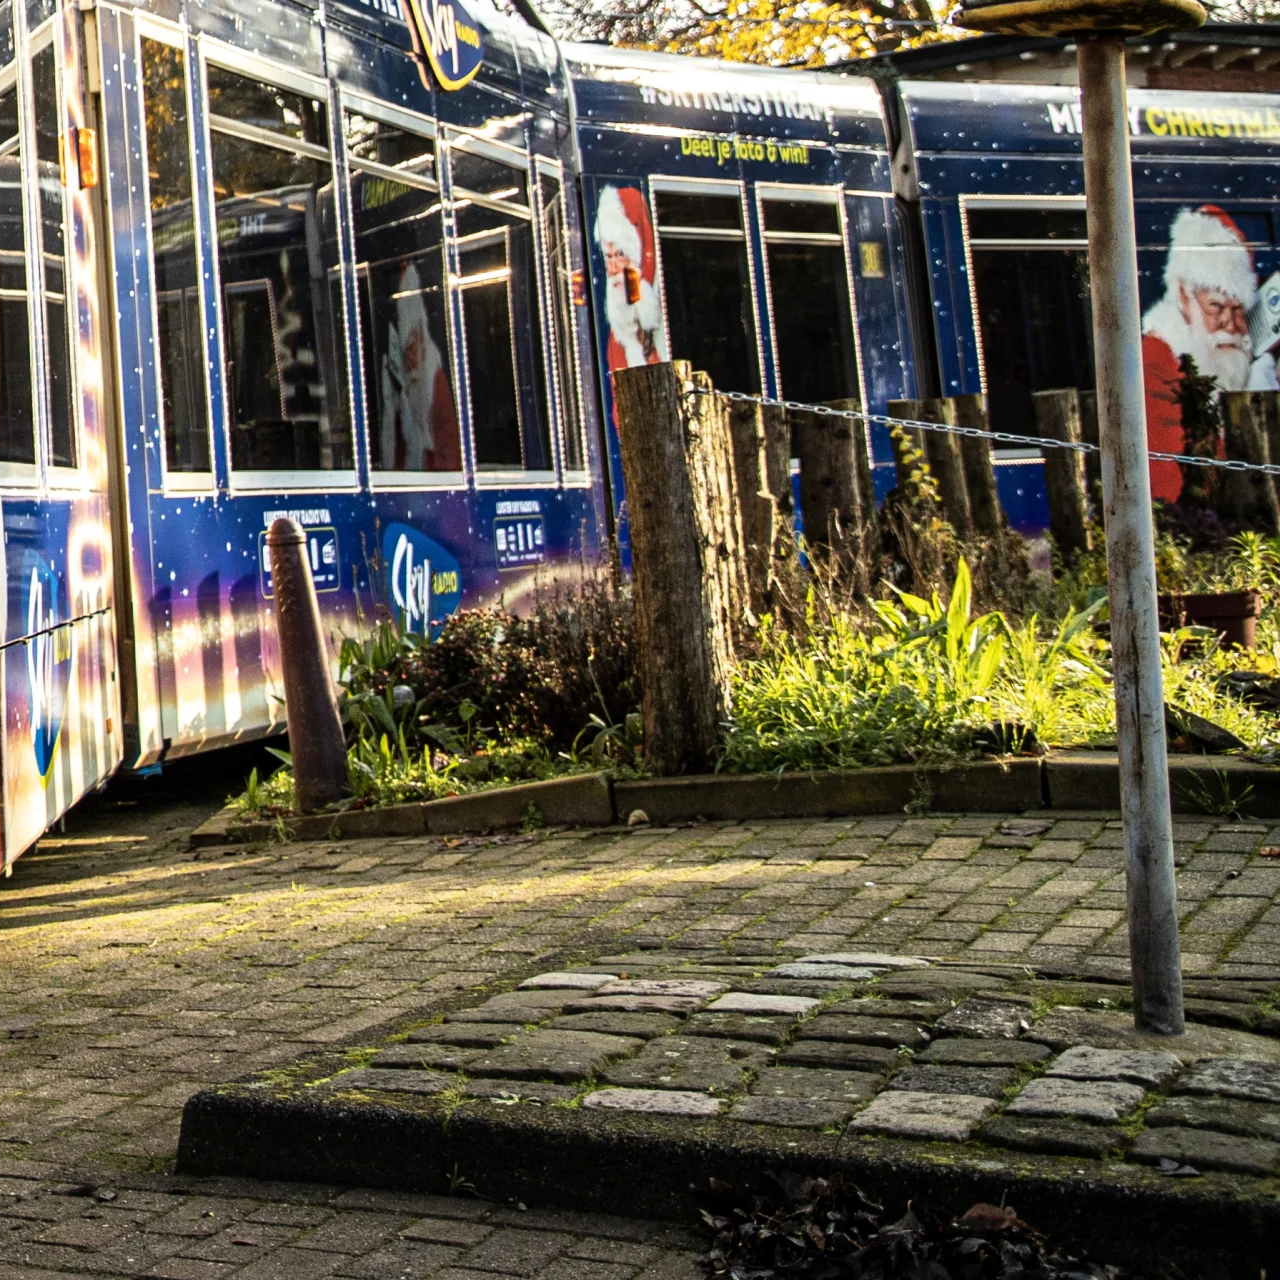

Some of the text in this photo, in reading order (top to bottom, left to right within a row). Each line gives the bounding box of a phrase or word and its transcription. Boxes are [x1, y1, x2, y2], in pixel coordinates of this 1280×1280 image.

[681, 136, 715, 158] Deel
[717, 140, 731, 166] je
[733, 135, 765, 161] foto
